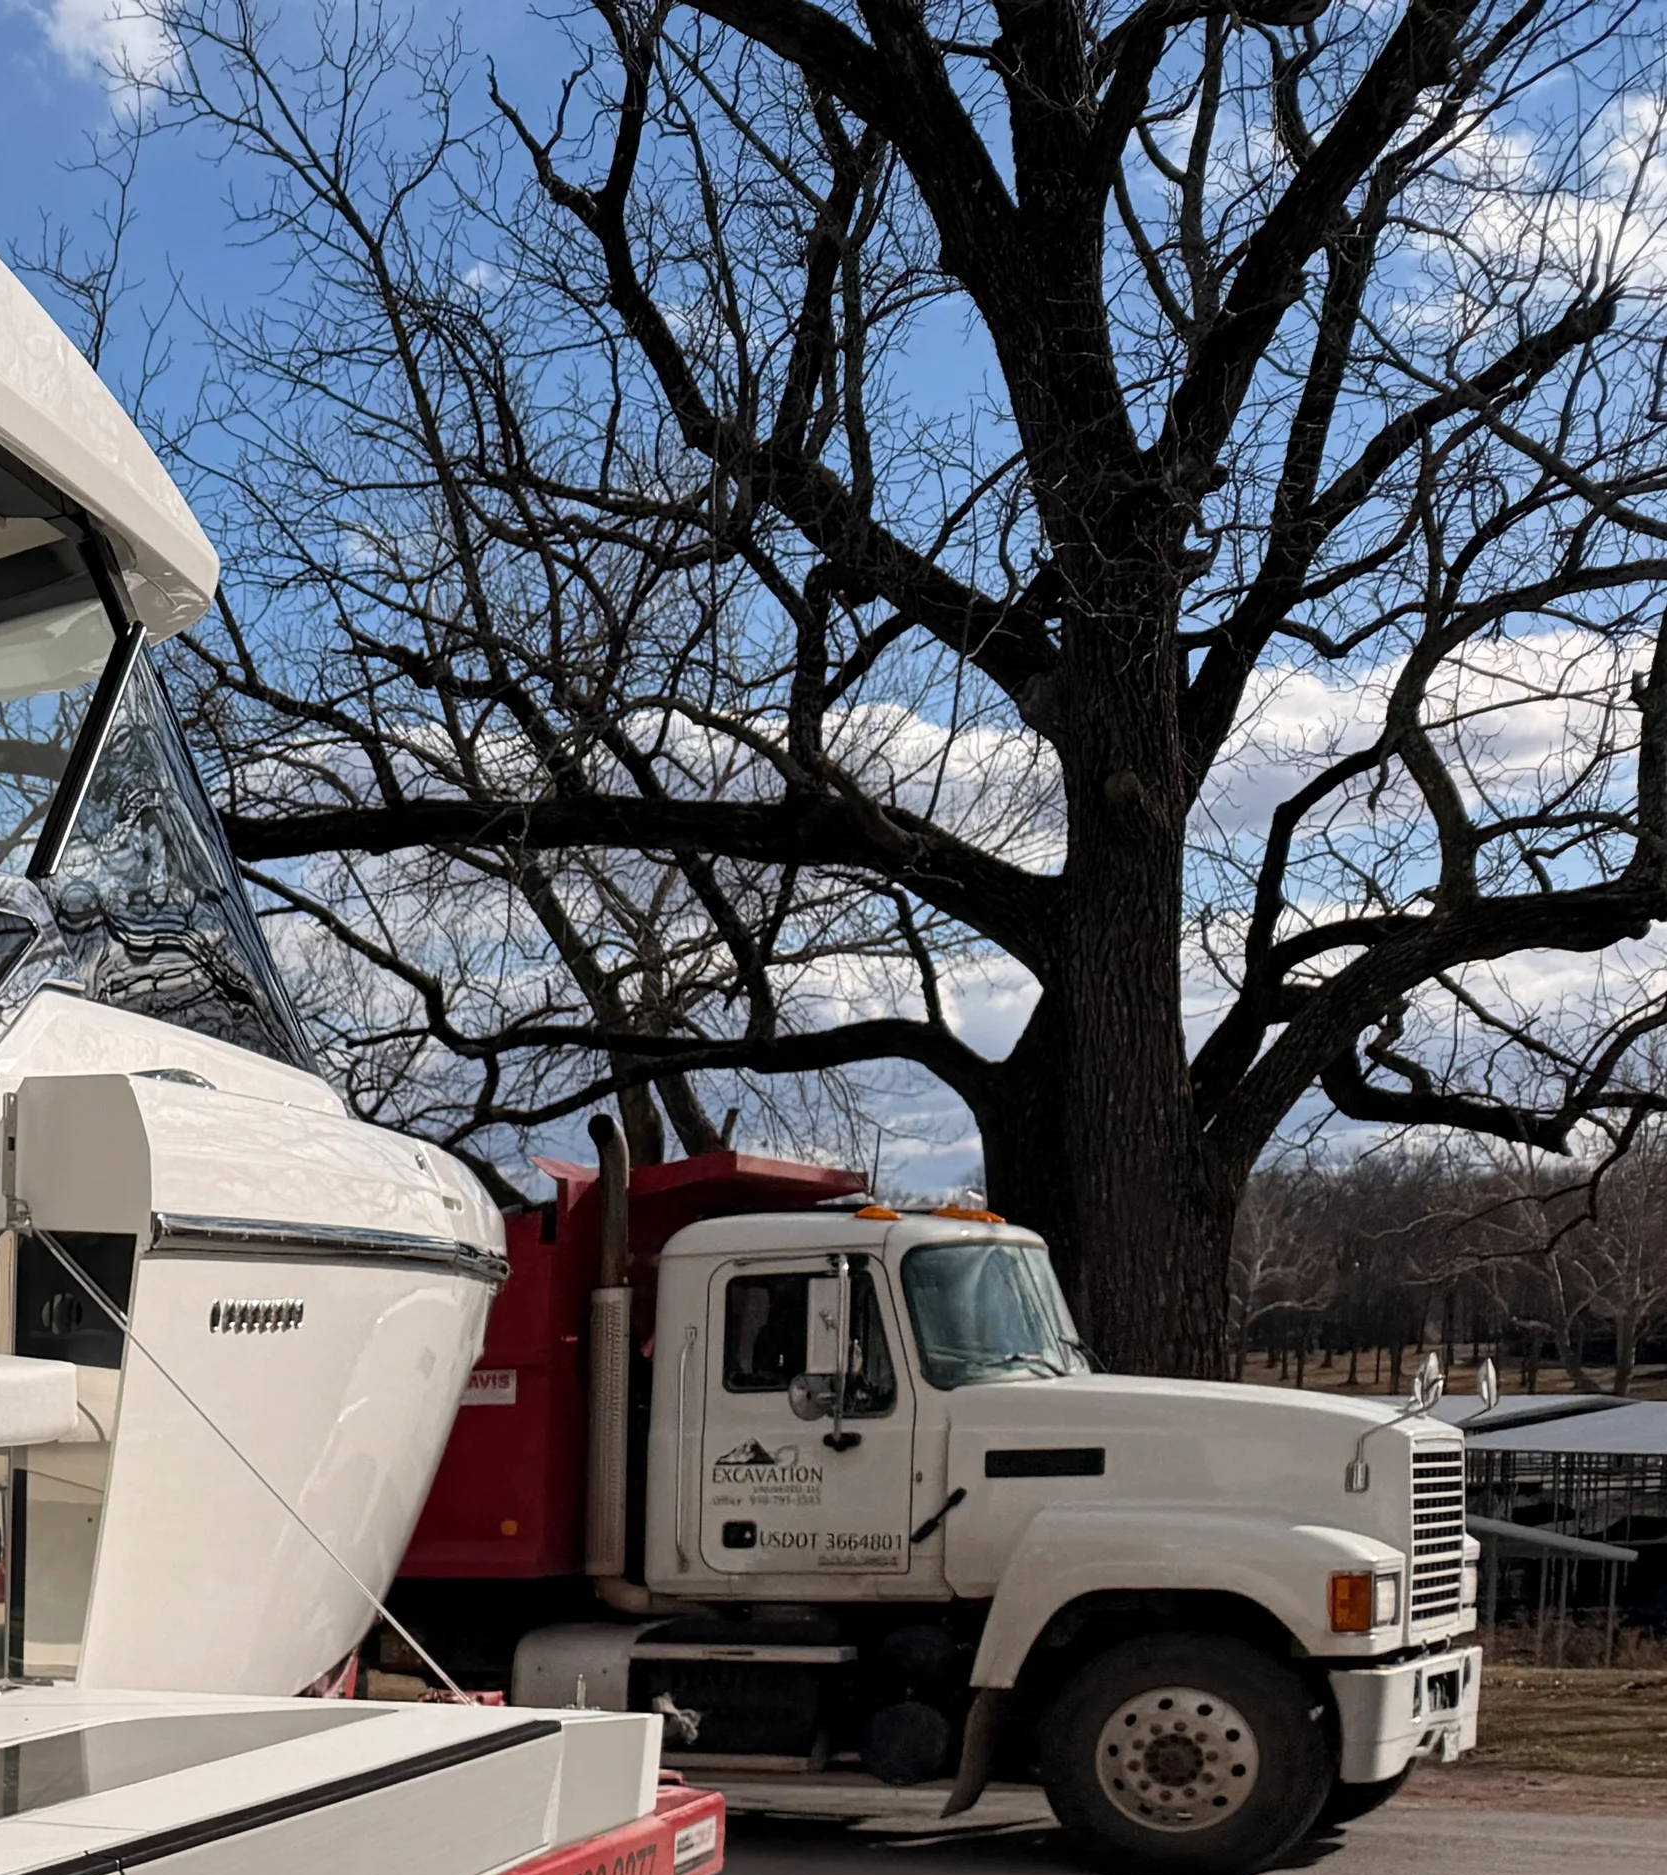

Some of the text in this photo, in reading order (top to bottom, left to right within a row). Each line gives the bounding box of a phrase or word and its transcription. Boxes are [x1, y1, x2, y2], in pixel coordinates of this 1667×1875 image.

[712, 1465, 823, 1484] EXCAVATION
[759, 1530, 902, 1551] USDOT 3664801
